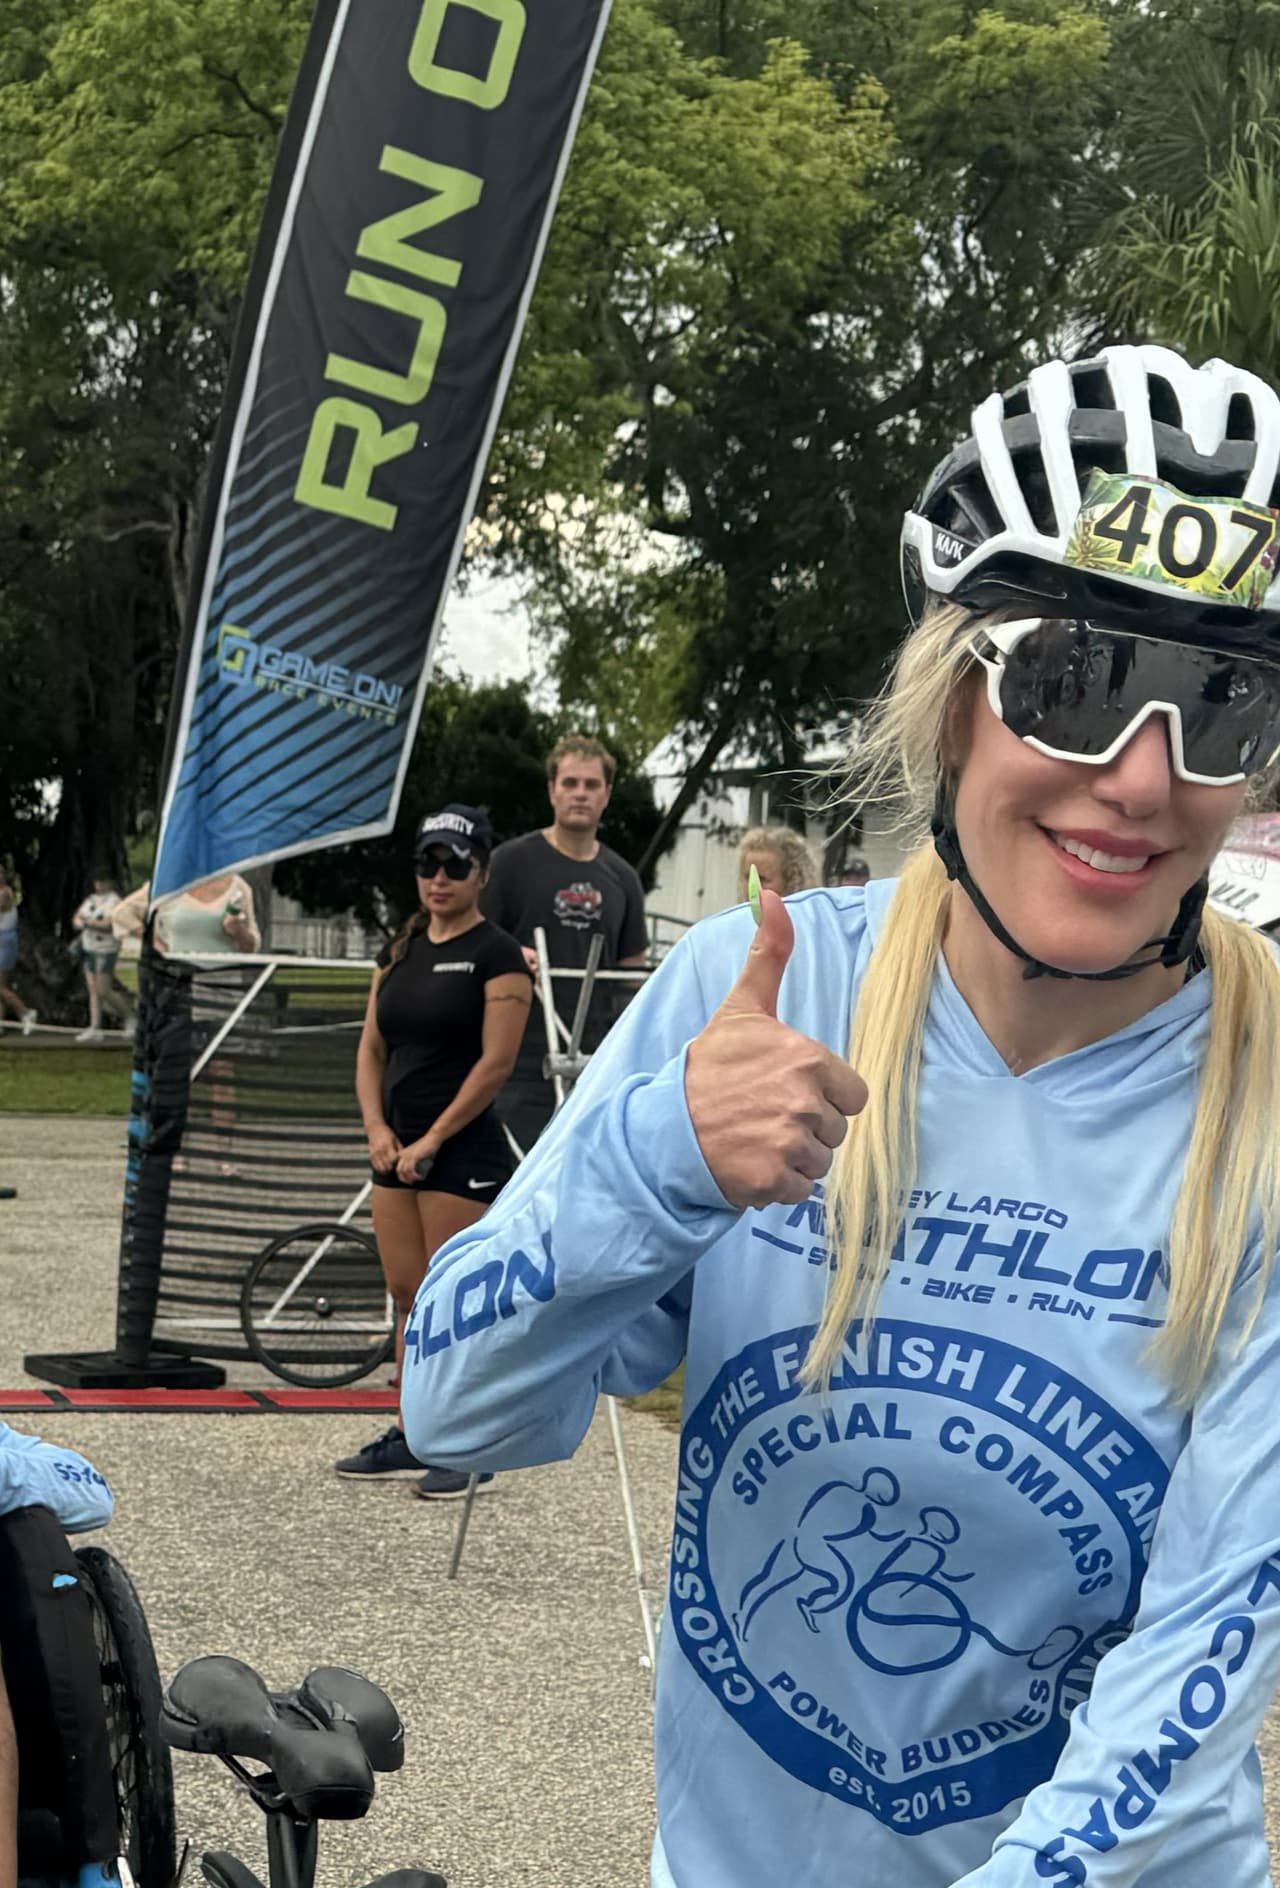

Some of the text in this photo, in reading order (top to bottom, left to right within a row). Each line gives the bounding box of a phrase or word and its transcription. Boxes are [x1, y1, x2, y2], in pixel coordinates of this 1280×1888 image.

[293, 145, 483, 531] RUN
[1093, 486, 1274, 591] 407
[259, 645, 350, 692] GAME
[317, 694, 398, 727] EVENTS
[422, 812, 476, 836] SECURITY
[897, 1189, 1068, 1230] EY LARGO
[922, 1277, 1095, 1321] BIKE RUN
[772, 1333, 985, 1392] FNISH
[710, 1370, 766, 1440] THE
[995, 1364, 1134, 1480] LINE
[732, 1402, 1114, 1596] SPECIAL COMPASS
[674, 1437, 755, 1706] CROSSING
[767, 1671, 1051, 1777] POWER BUDDIES
[828, 1767, 972, 1824] est. 2015
